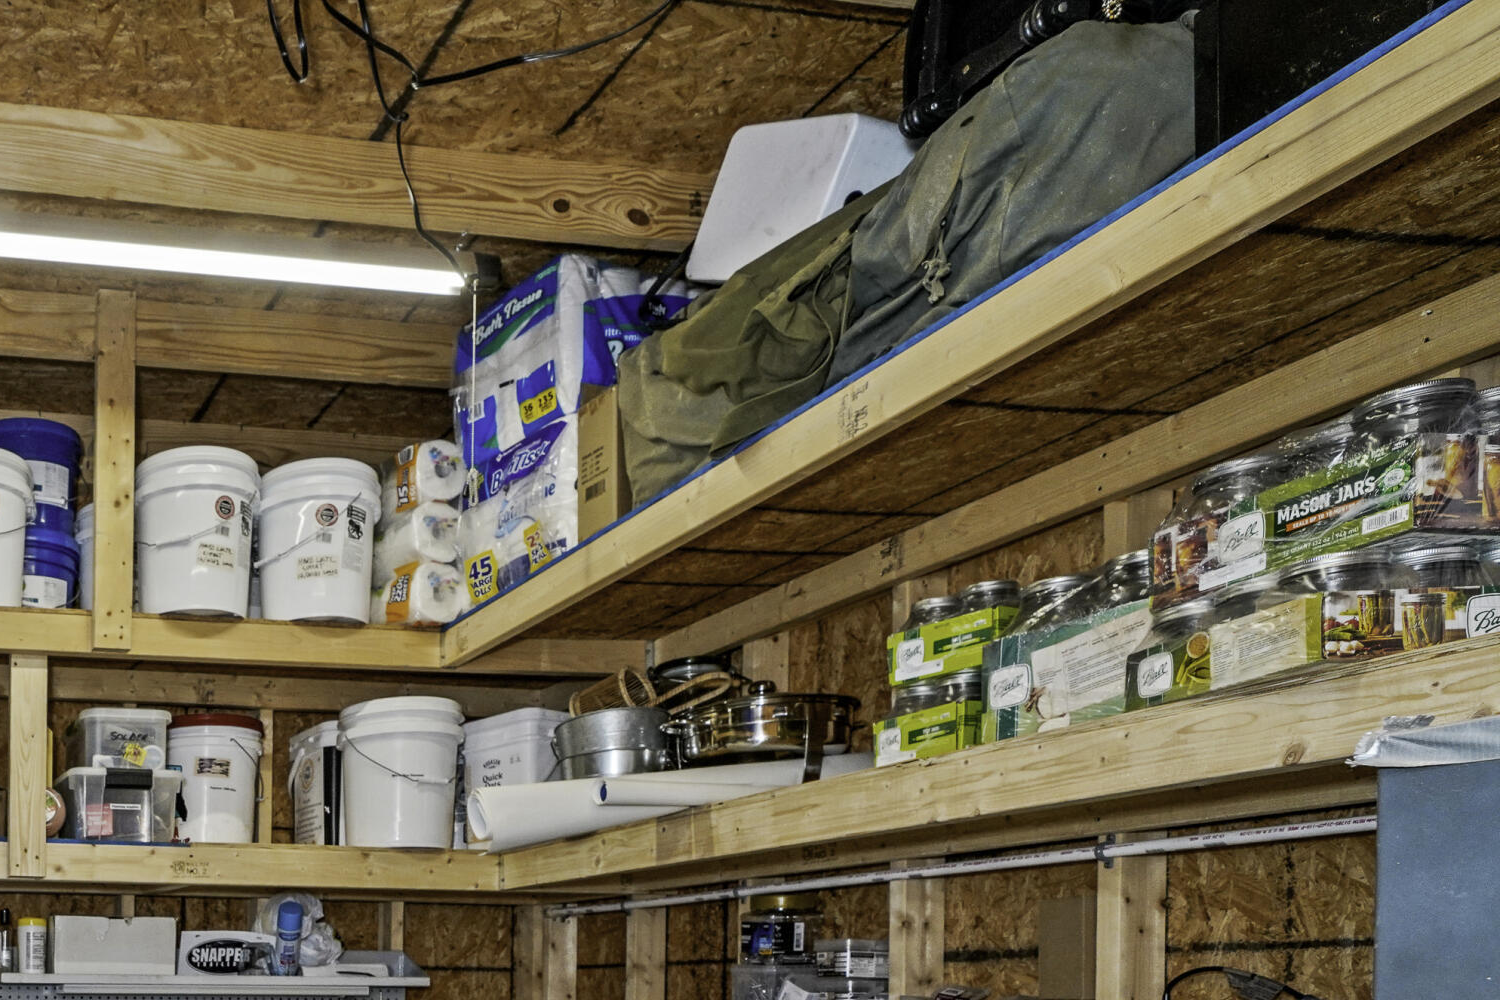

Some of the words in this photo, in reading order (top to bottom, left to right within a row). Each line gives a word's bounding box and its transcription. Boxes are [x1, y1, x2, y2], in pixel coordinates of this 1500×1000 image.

[474, 311, 505, 345] Bath
[503, 288, 543, 319] Tissue
[523, 403, 534, 415] 36
[1277, 492, 1332, 525] MASON
[1333, 475, 1377, 505] JARS
[1224, 520, 1259, 553] Ball
[468, 556, 493, 581] 45
